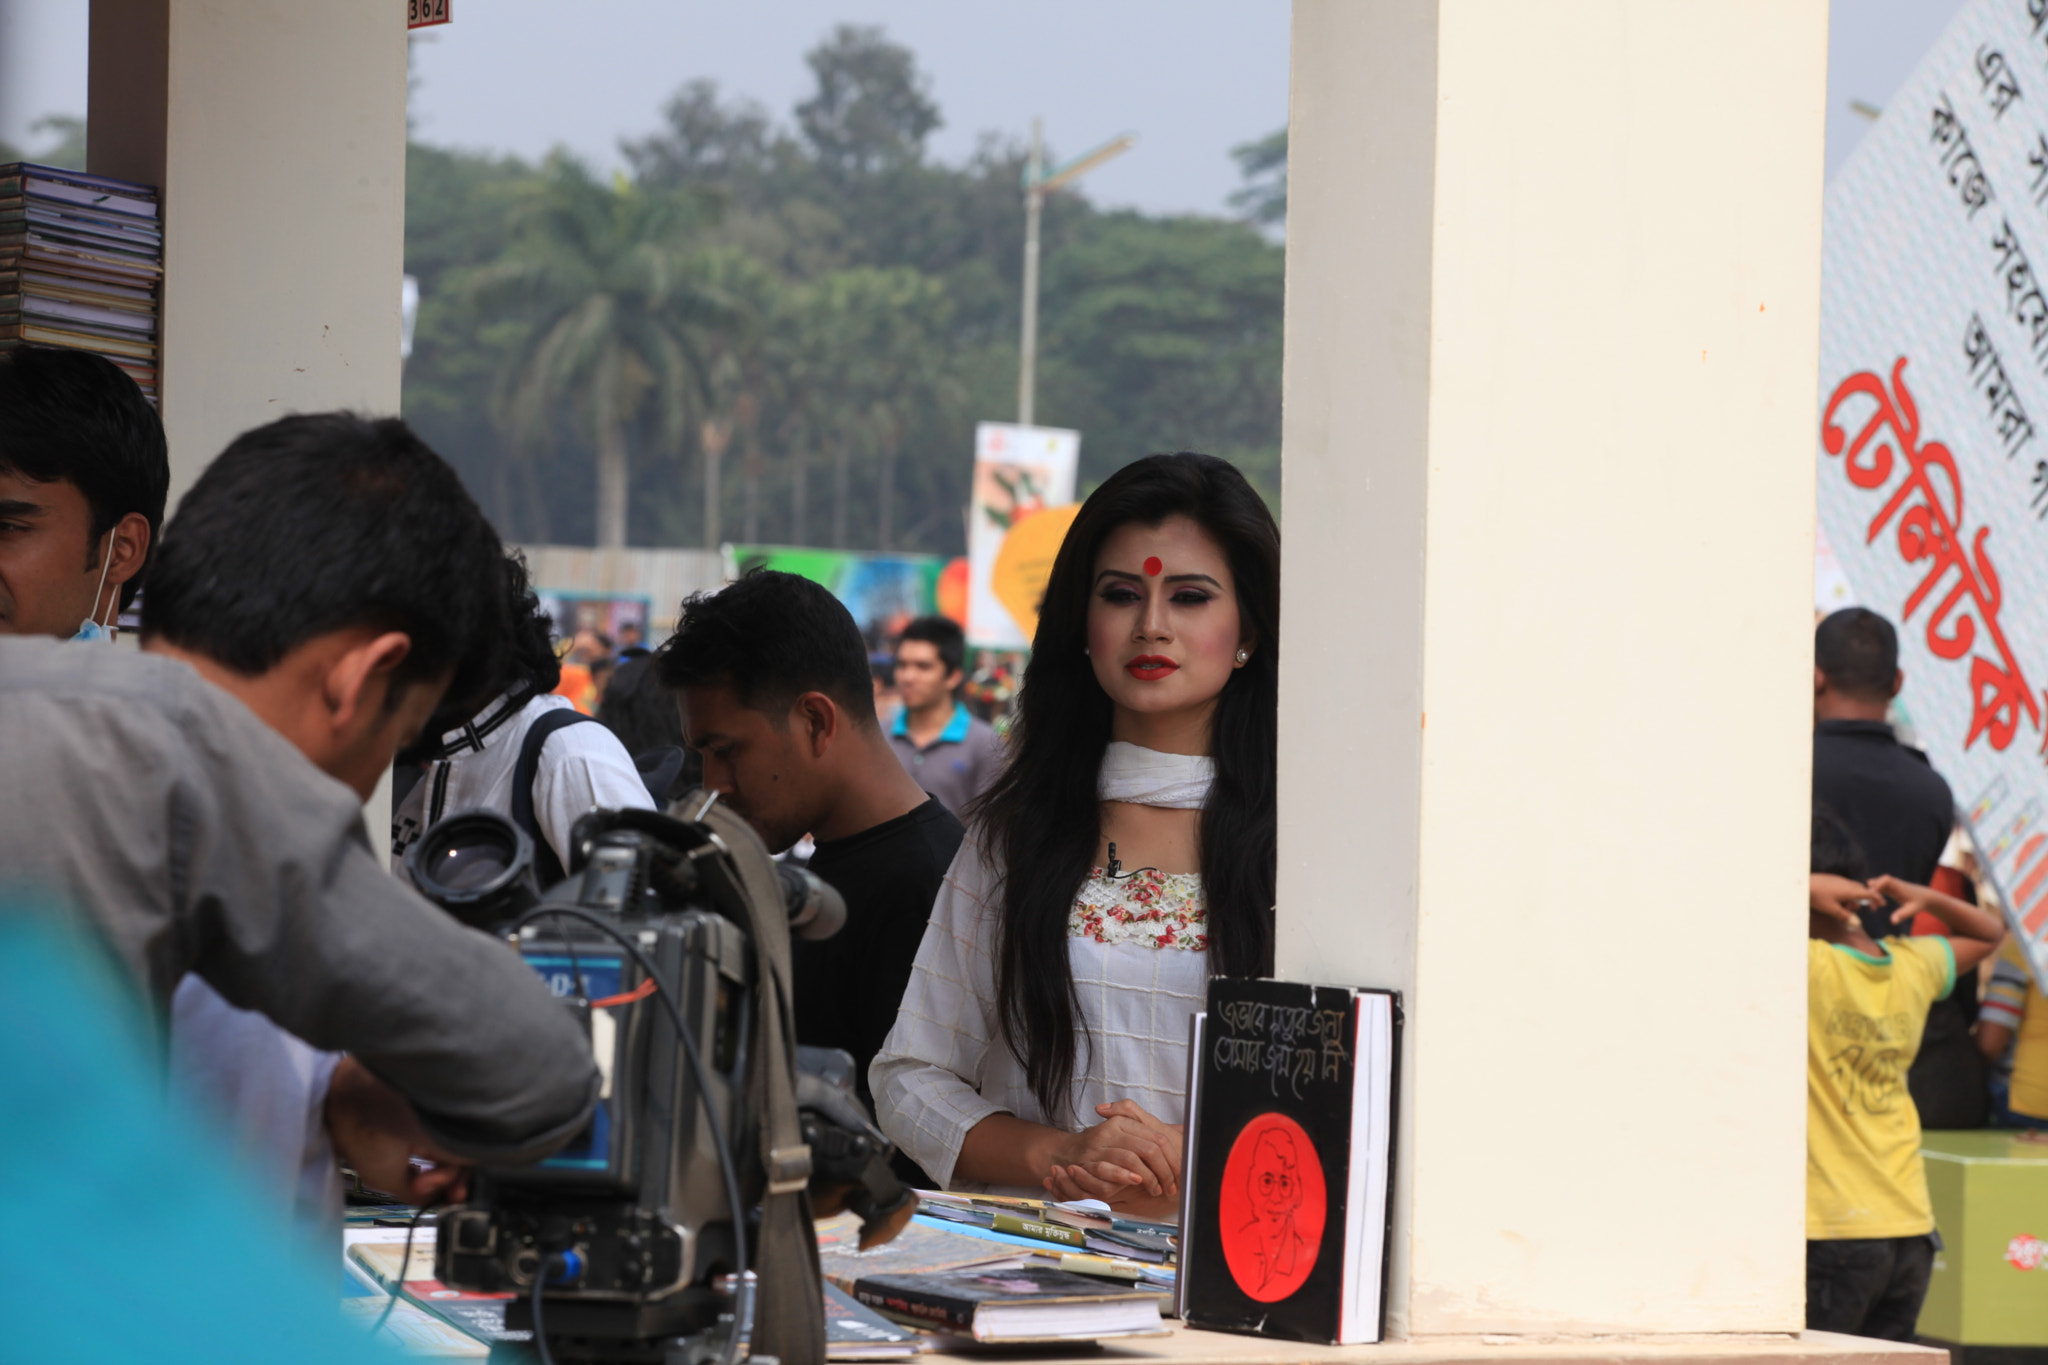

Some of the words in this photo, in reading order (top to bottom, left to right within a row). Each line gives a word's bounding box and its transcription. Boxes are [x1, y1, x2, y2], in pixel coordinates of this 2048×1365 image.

[410, 0, 443, 20] 362
[1974, 43, 2022, 120] এর
[1931, 90, 1996, 220] কাজে
[1992, 217, 2048, 377] সহযো
[1963, 311, 2036, 459] আমরা
[1822, 356, 2041, 752] টেলিটক
[1213, 1036, 1265, 1074] তোমার
[1021, 1222, 1044, 1235] আমার
